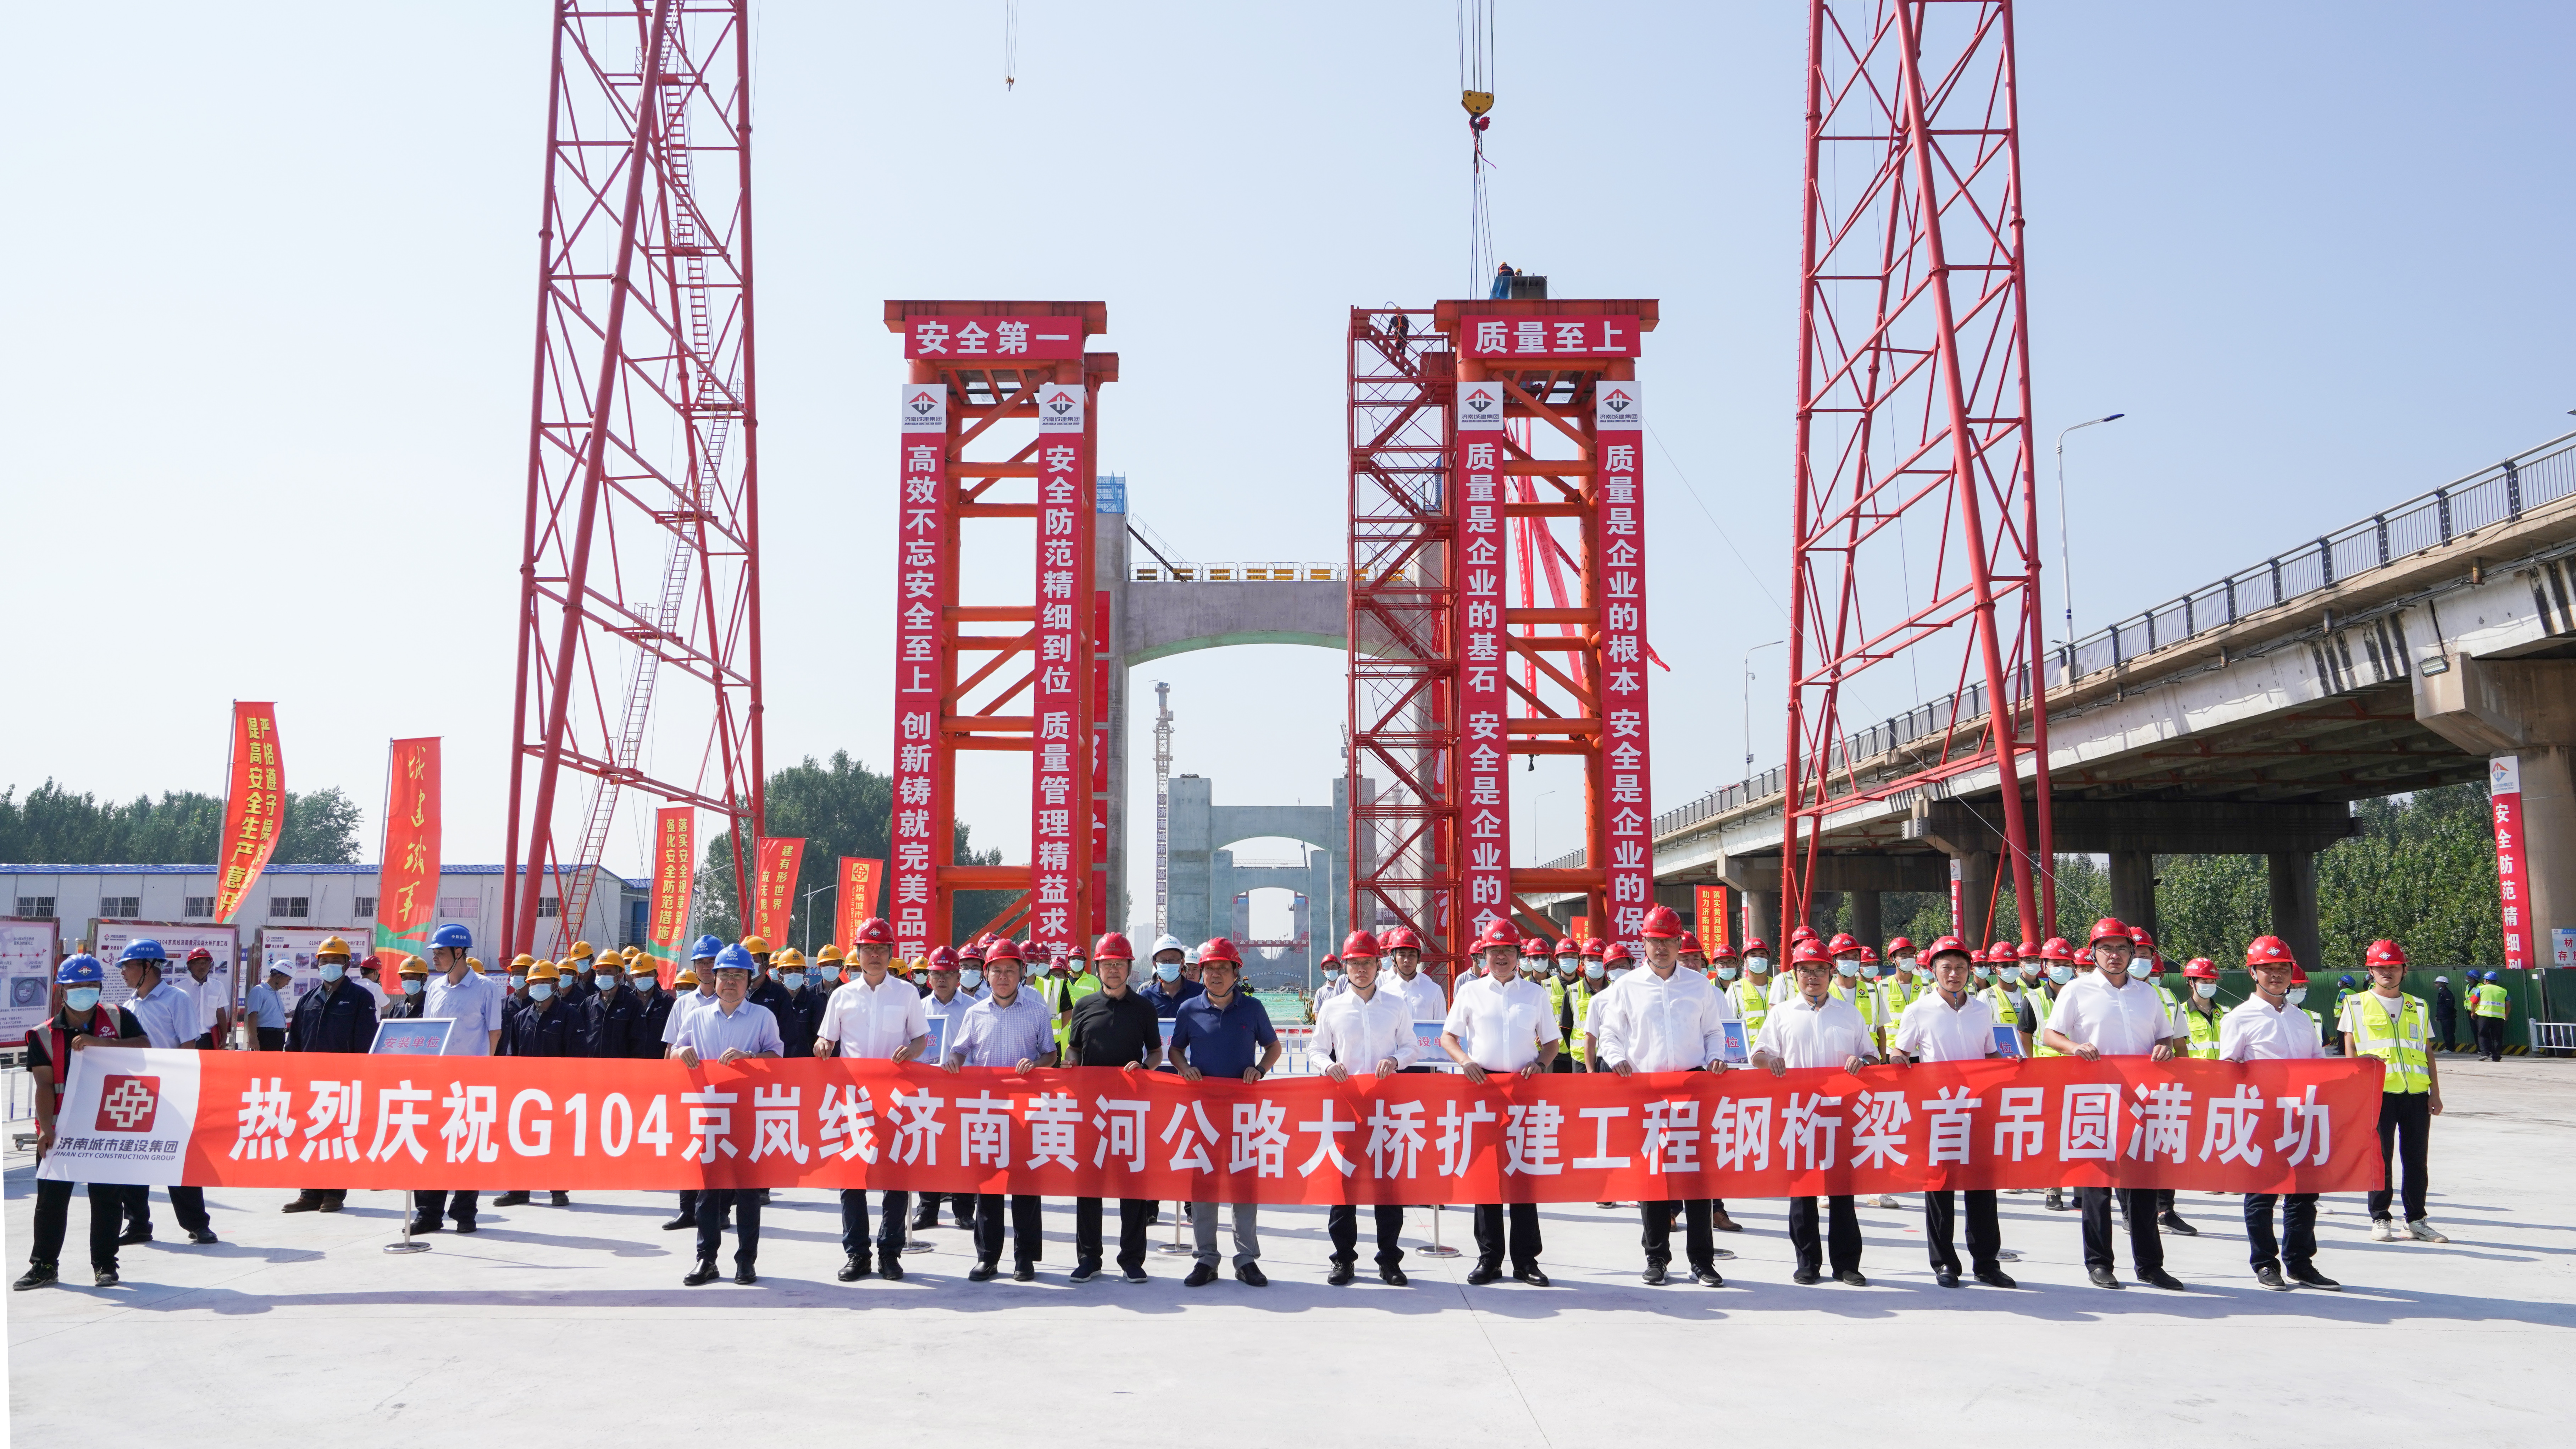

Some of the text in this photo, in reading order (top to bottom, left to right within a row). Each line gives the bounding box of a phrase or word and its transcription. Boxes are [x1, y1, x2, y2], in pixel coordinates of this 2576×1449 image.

[916, 321, 1069, 354] 安全第一
[1474, 321, 1627, 354] 质量至上
[902, 445, 937, 693] 高效不忘安全至上
[1041, 445, 1075, 695] 安全防范精细到位
[1465, 442, 1498, 693] 质量是企业的基石
[1605, 444, 1641, 696] 质量是企业的根本
[218, 717, 263, 913] 提高安全生产意识
[657, 819, 676, 940] 强化安全防范措施
[671, 818, 688, 940] 落实安全规章制度
[772, 845, 794, 911] 建有形世界
[1157, 808, 1167, 904] 济南城市建设集团
[760, 871, 771, 939] 筑无限梦想
[853, 884, 865, 953] 济南城市建
[1702, 890, 1711, 959] 助力济南拥河发展
[2564, 938, 2573, 948] 材
[382, 1036, 441, 1049] 安装单位
[1725, 1036, 1739, 1048] 位
[1999, 1041, 2013, 1054] 位
[56, 1137, 179, 1153] 济南城市建设集团
[229, 1077, 2331, 1180] 热烈庆祝G104京岚线济南黄河公路大桥扩建工程钢桁梁首吊圆满成功
